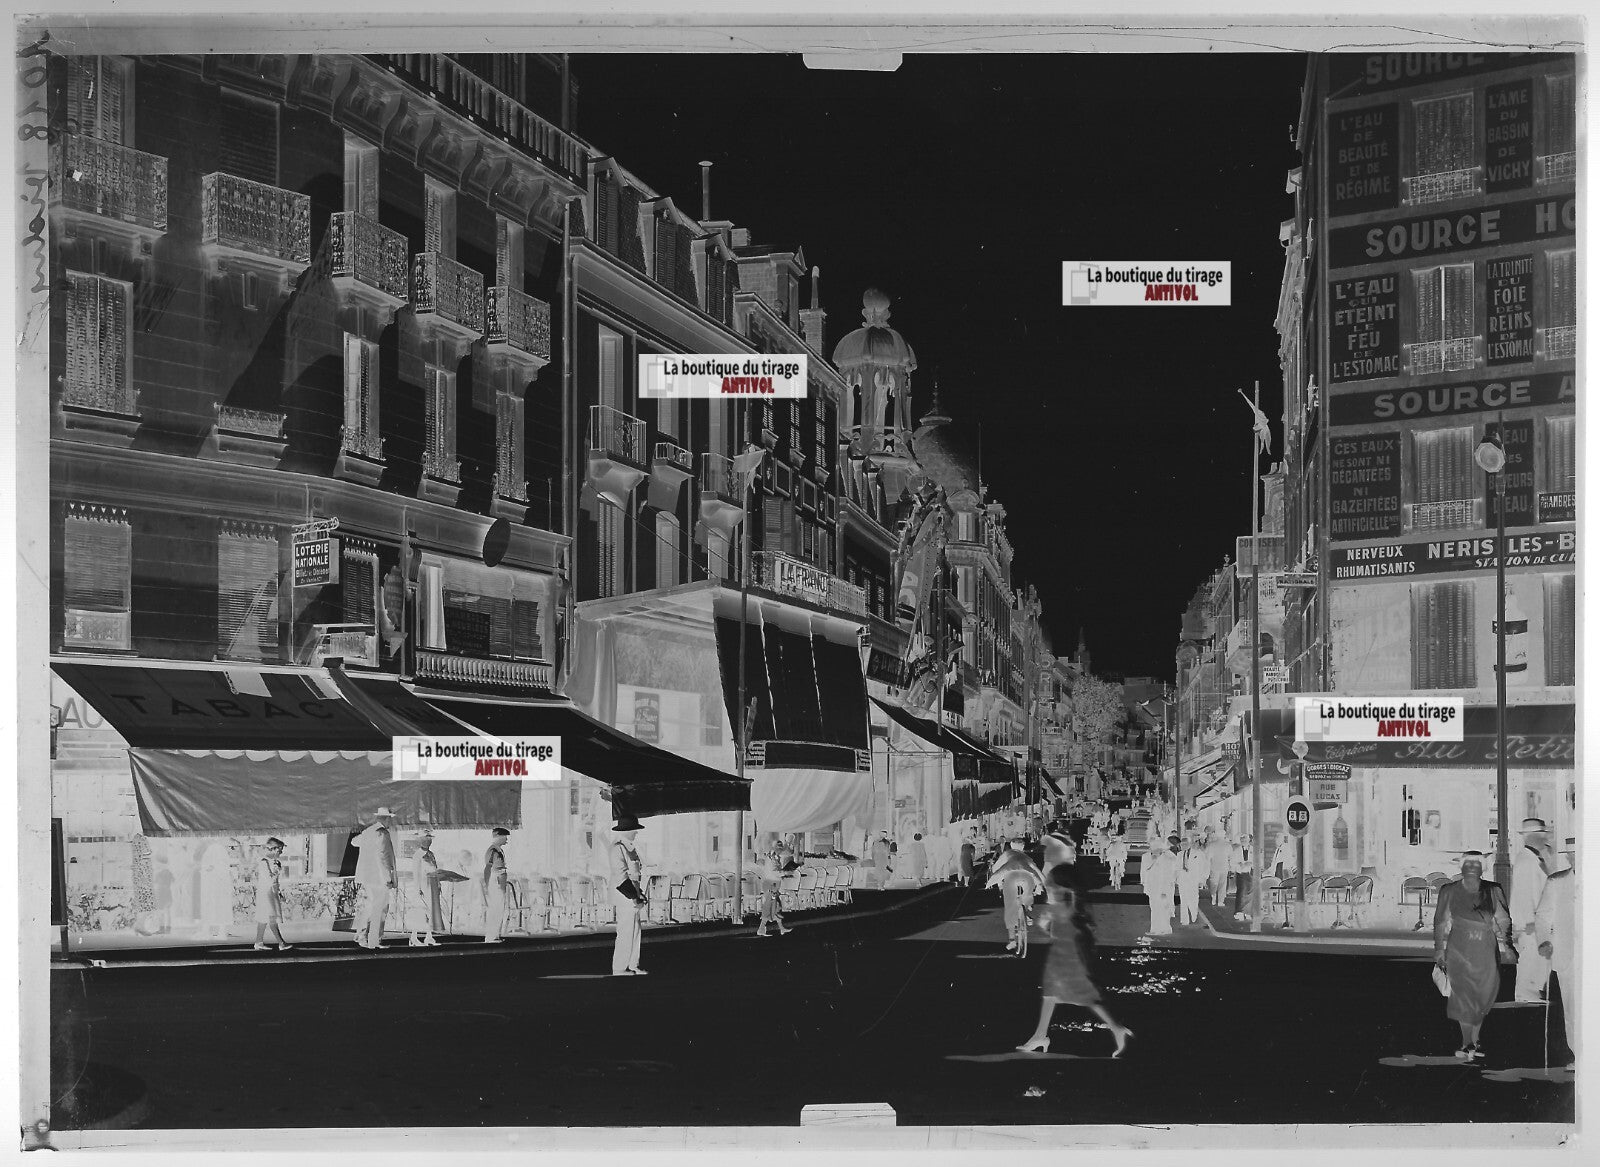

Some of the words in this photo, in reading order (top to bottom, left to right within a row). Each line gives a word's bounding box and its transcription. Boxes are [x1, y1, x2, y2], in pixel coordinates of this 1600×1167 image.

[1341, 112, 1383, 131] L'EAU
[1500, 110, 1518, 121] DU
[1354, 131, 1375, 142] DE
[1487, 121, 1529, 143] BASSIN
[1498, 146, 1516, 158] DE
[1349, 166, 1360, 177] ET
[1367, 163, 1380, 174] DE
[1488, 160, 1530, 182] VICHY
[1365, 209, 1501, 258] SOURCE
[1487, 263, 1498, 280] LA
[1335, 277, 1395, 300] L'EAU
[1498, 277, 1520, 286] DU
[1494, 285, 1527, 305] FOIE
[1496, 304, 1522, 314] DES
[1353, 323, 1374, 333] LE
[1489, 311, 1532, 333] REINS
[1347, 330, 1381, 351] FEU
[1500, 332, 1517, 341] DE
[1487, 338, 1533, 360] L'ESTOMAC
[1333, 355, 1399, 378] L'ESTOMAC
[1373, 380, 1532, 418] SOURCE
[1361, 439, 1395, 453] EAUX
[1332, 459, 1345, 469] NE
[1347, 457, 1372, 468] SONT
[1377, 455, 1391, 465] NI
[1353, 486, 1369, 496] NI
[295, 542, 329, 558] LOTERIE
[1347, 545, 1404, 561] NERVEUX
[1428, 539, 1494, 559] NERIS
[295, 554, 329, 569] NATIONALE
[1336, 561, 1416, 578] RHUMATISANTS
[112, 694, 334, 720] TABAC
